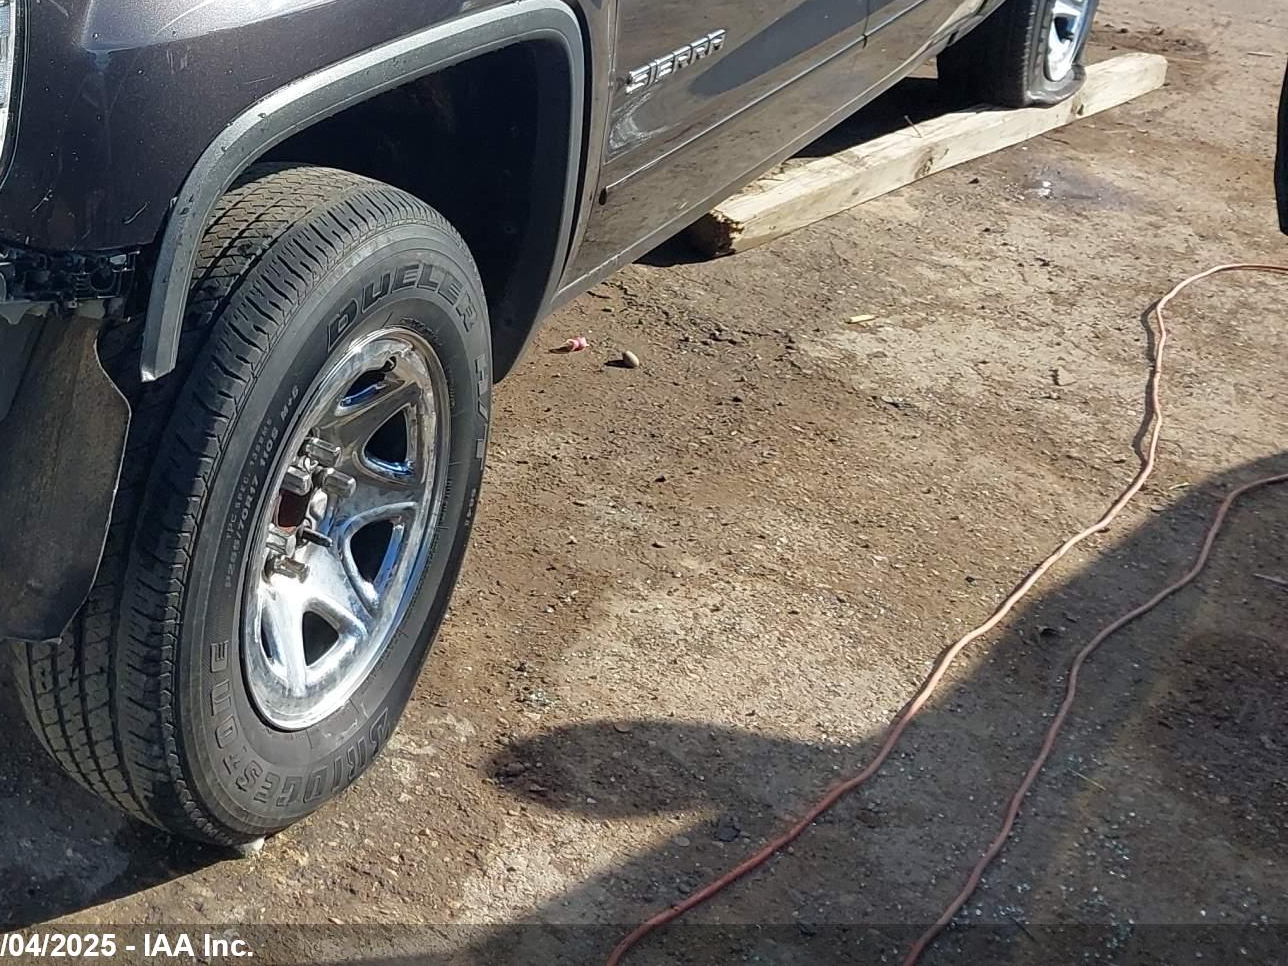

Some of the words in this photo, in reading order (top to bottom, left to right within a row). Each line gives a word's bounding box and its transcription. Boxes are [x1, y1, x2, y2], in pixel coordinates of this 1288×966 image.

[625, 29, 726, 93] SIERRA
[327, 263, 479, 353] DUELER
[209, 639, 391, 808] BRIDGESTONE
